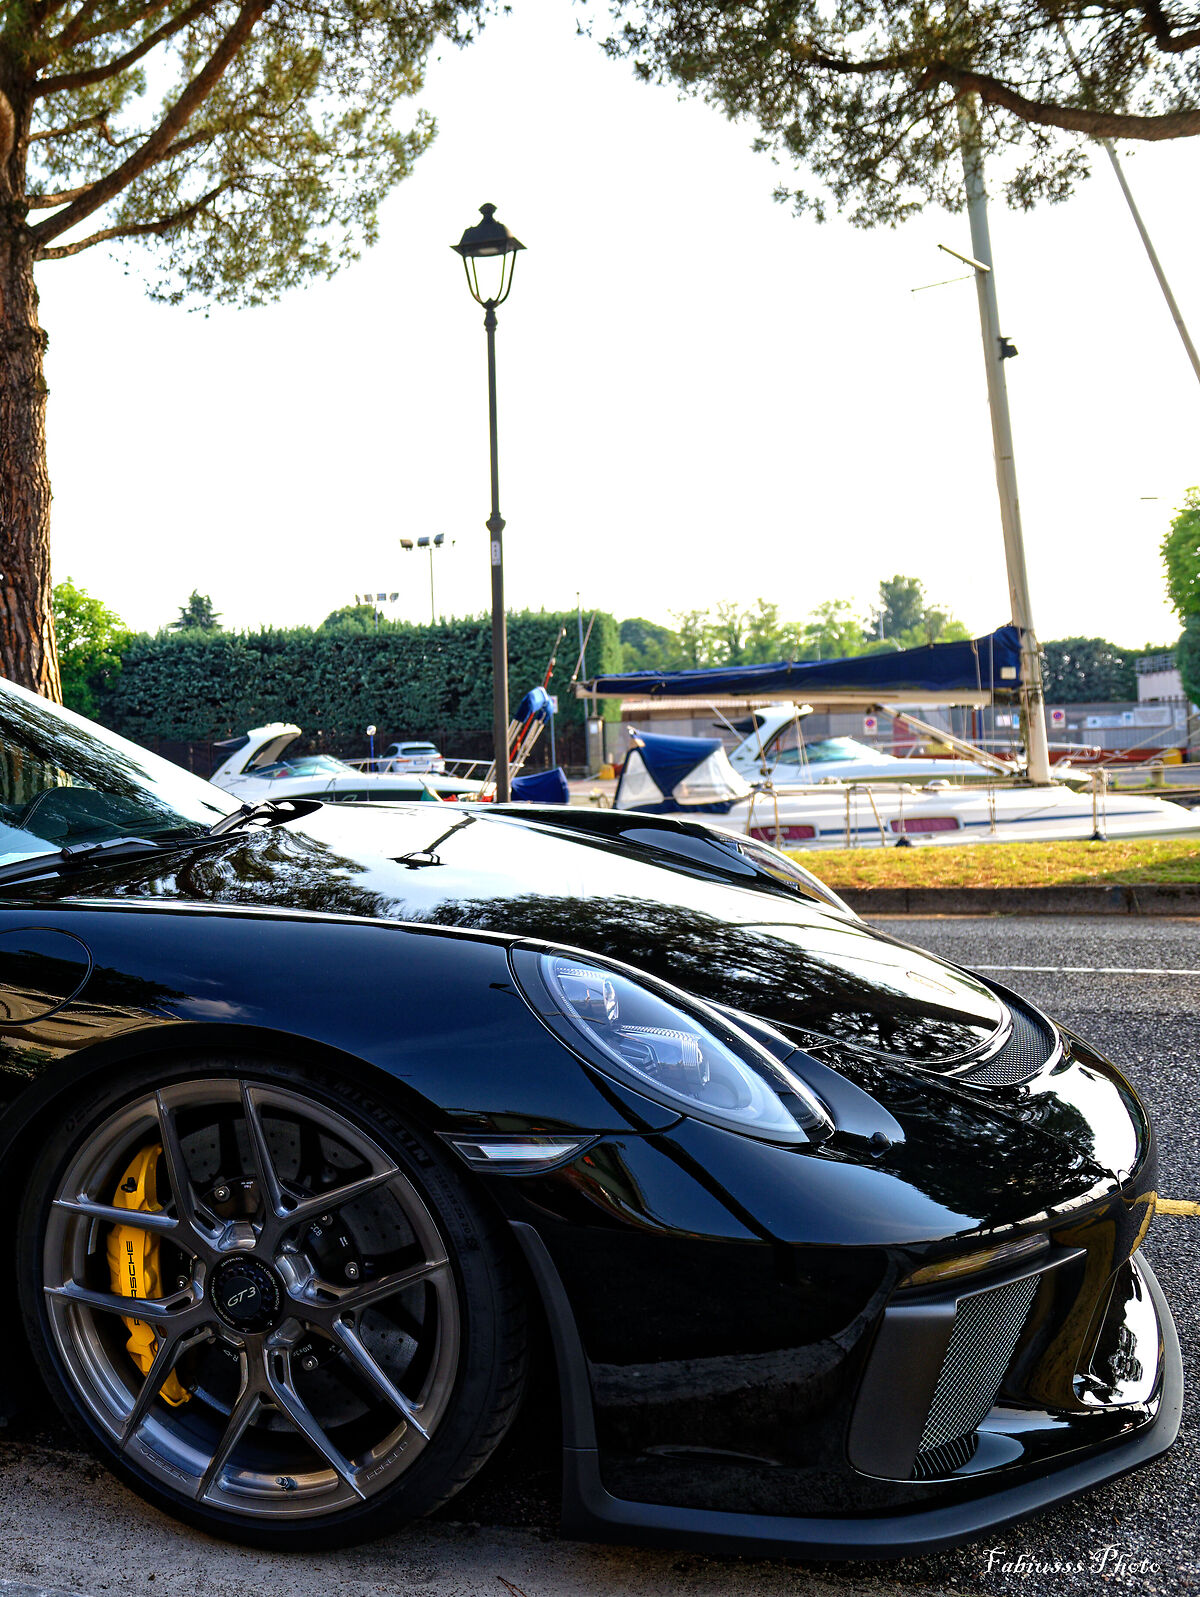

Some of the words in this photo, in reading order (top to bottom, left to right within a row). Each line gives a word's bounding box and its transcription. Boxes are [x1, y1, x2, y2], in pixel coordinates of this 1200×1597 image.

[332, 1081, 432, 1167] MICHELIN
[125, 1240, 141, 1326] PRSCHE
[227, 1286, 257, 1307] GT3
